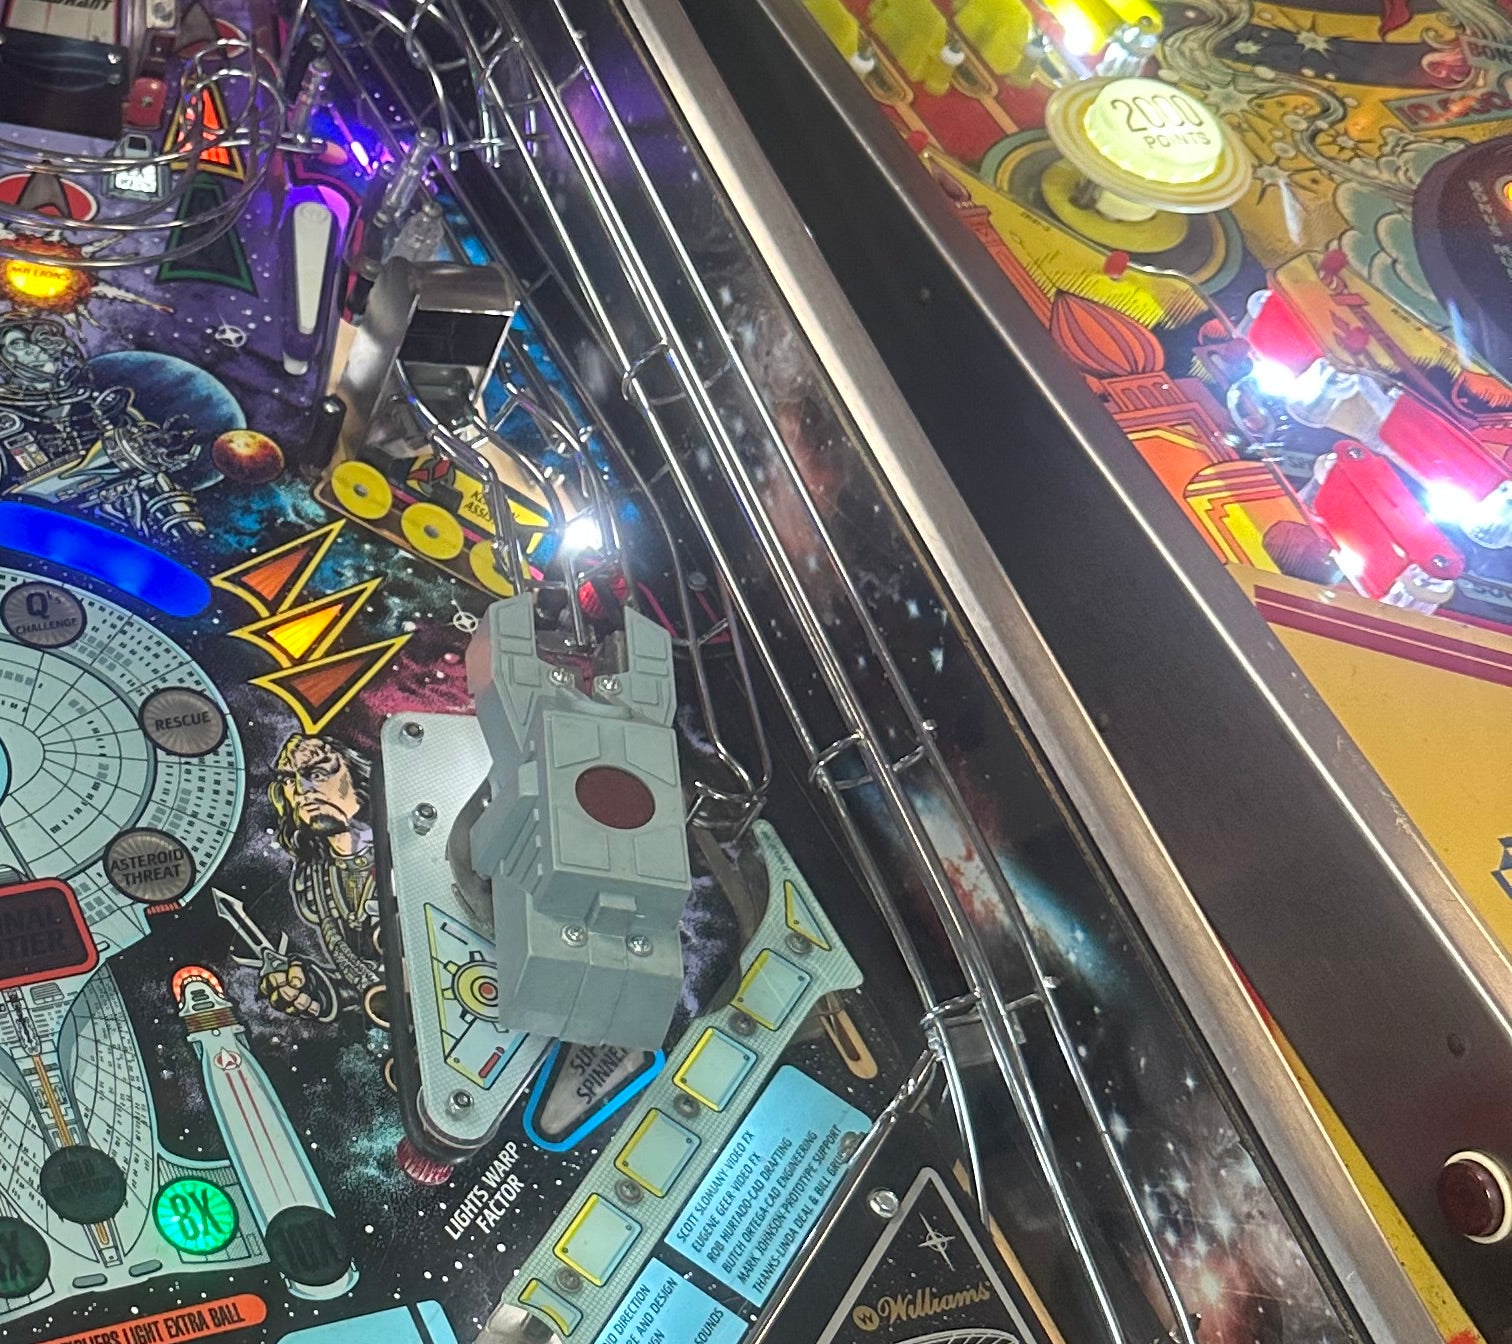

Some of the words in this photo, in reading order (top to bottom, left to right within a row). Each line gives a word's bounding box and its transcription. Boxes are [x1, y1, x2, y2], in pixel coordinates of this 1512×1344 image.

[1110, 94, 1200, 134] 2000
[16, 617, 78, 635] CHALLENGE
[155, 711, 211, 732] RESCUE
[110, 848, 185, 873] ASTEROID
[122, 865, 181, 887] THREAT
[445, 1185, 489, 1240] LIGHTS
[481, 1141, 520, 1189] WARP
[476, 1174, 524, 1234] FACTOR
[170, 1188, 224, 1241] 8X
[166, 1313, 209, 1340] EXTRA
[209, 1302, 246, 1329] BALL
[614, 1285, 651, 1337] DIRECTION
[638, 1309, 655, 1338] AND
[651, 1277, 679, 1313] DESIGN
[878, 1282, 990, 1324] Williams
